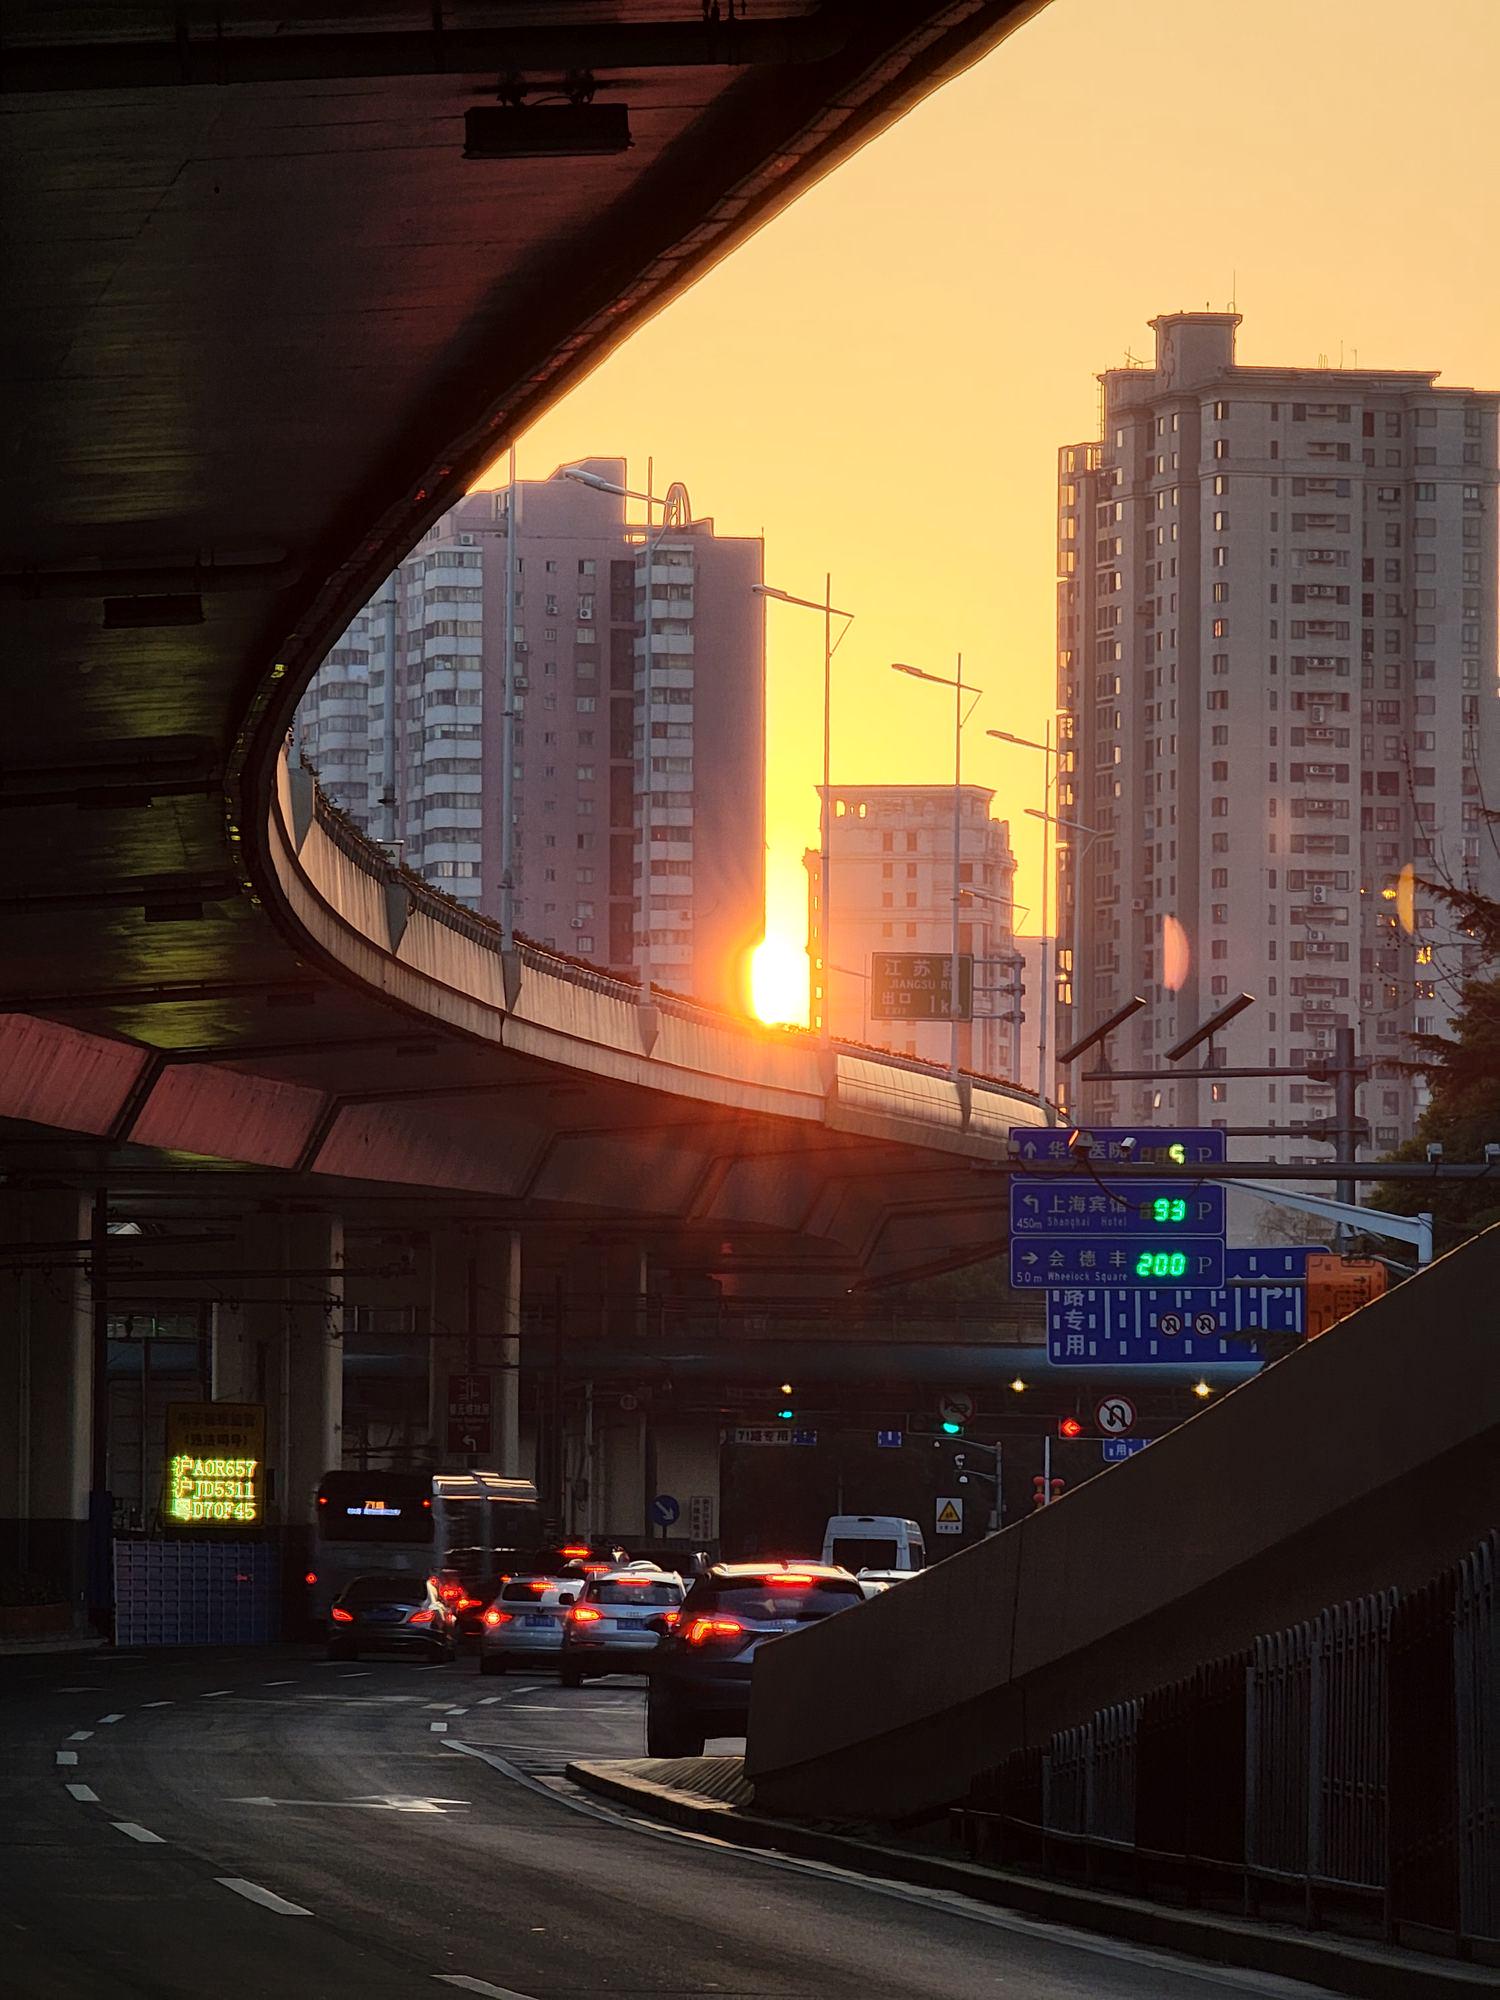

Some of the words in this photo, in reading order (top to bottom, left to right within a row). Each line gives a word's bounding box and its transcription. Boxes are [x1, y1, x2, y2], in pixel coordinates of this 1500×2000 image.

[889, 980, 936, 990] JIANGSU
[882, 992, 911, 1005] 出口
[1048, 1140, 1128, 1159] 华医院
[1198, 1147, 1212, 1162] P
[1048, 1195, 1127, 1213] 上海宾馆
[1154, 1198, 1185, 1221] 93
[1198, 1202, 1212, 1220] P
[1017, 1218, 1042, 1229] 450m
[1047, 1217, 1090, 1229] Shanghai
[1101, 1217, 1127, 1227] Hotel
[1049, 1250, 1127, 1267] 会德丰
[1137, 1253, 1186, 1277] 200
[1198, 1256, 1212, 1274] P
[1048, 1272, 1090, 1281] Wheelock
[1095, 1272, 1127, 1283] Square
